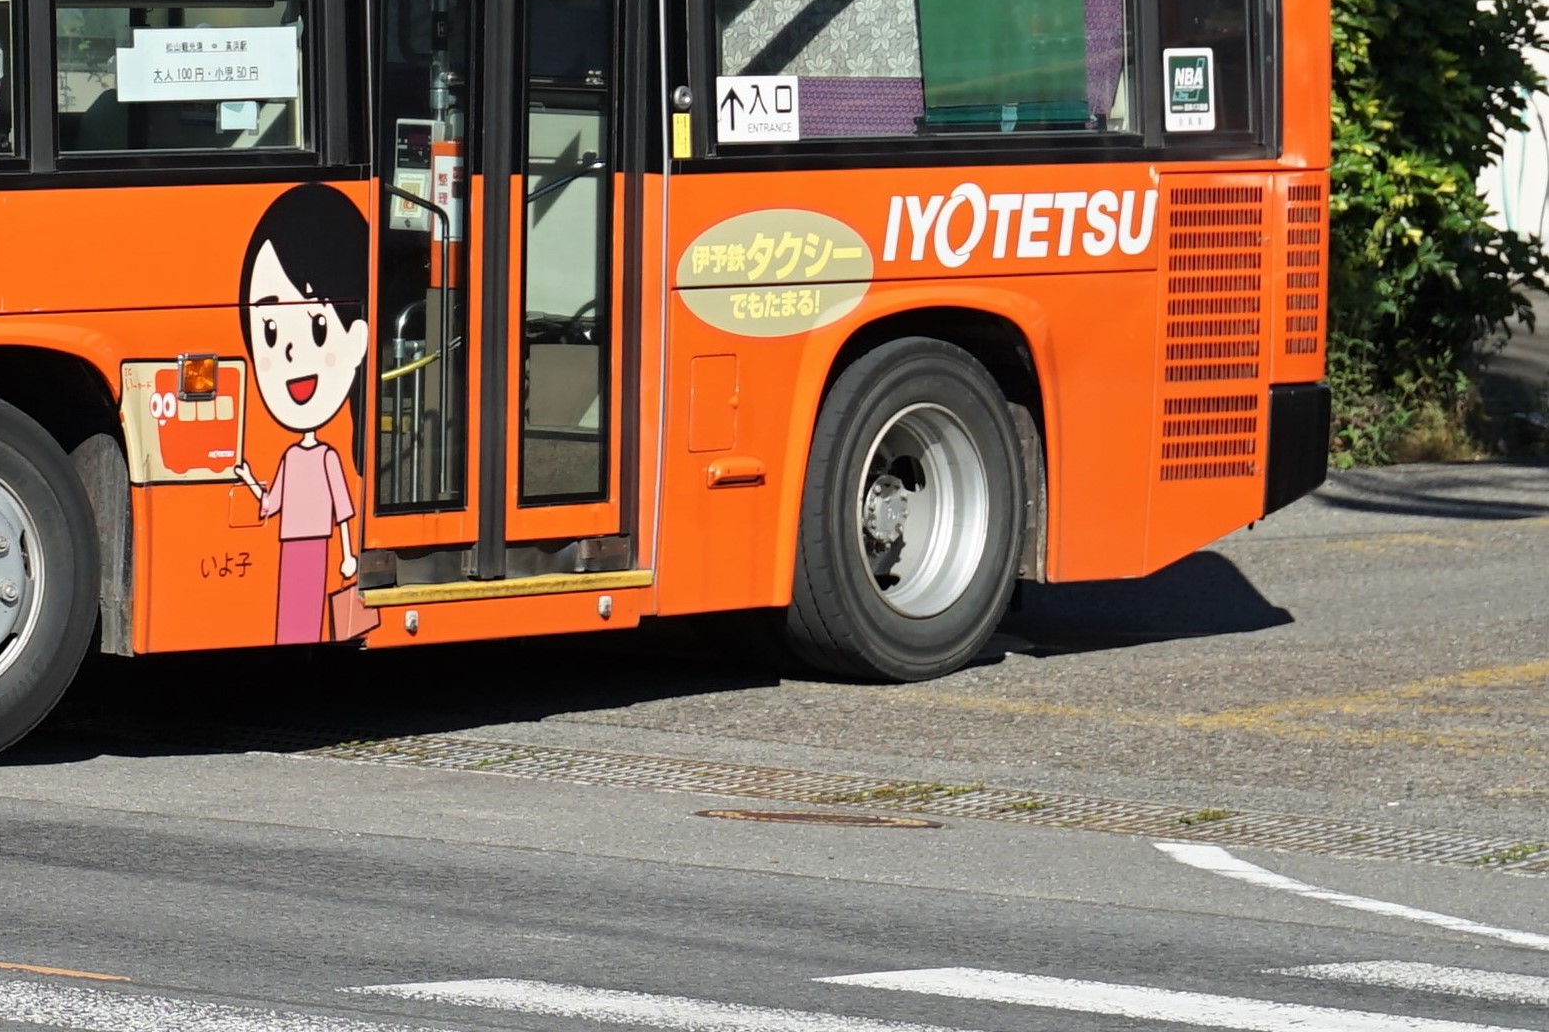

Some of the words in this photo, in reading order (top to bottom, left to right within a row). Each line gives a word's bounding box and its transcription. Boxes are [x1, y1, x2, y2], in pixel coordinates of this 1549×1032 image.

[1174, 67, 1204, 87] NBA
[749, 84, 792, 115] 入口
[747, 122, 792, 134] ENTRANCE
[883, 182, 1159, 268] IYOTETSU
[691, 231, 863, 281] 伊予鉄タクシー
[729, 289, 821, 320] でもたまる!
[200, 551, 253, 579] いよ子
